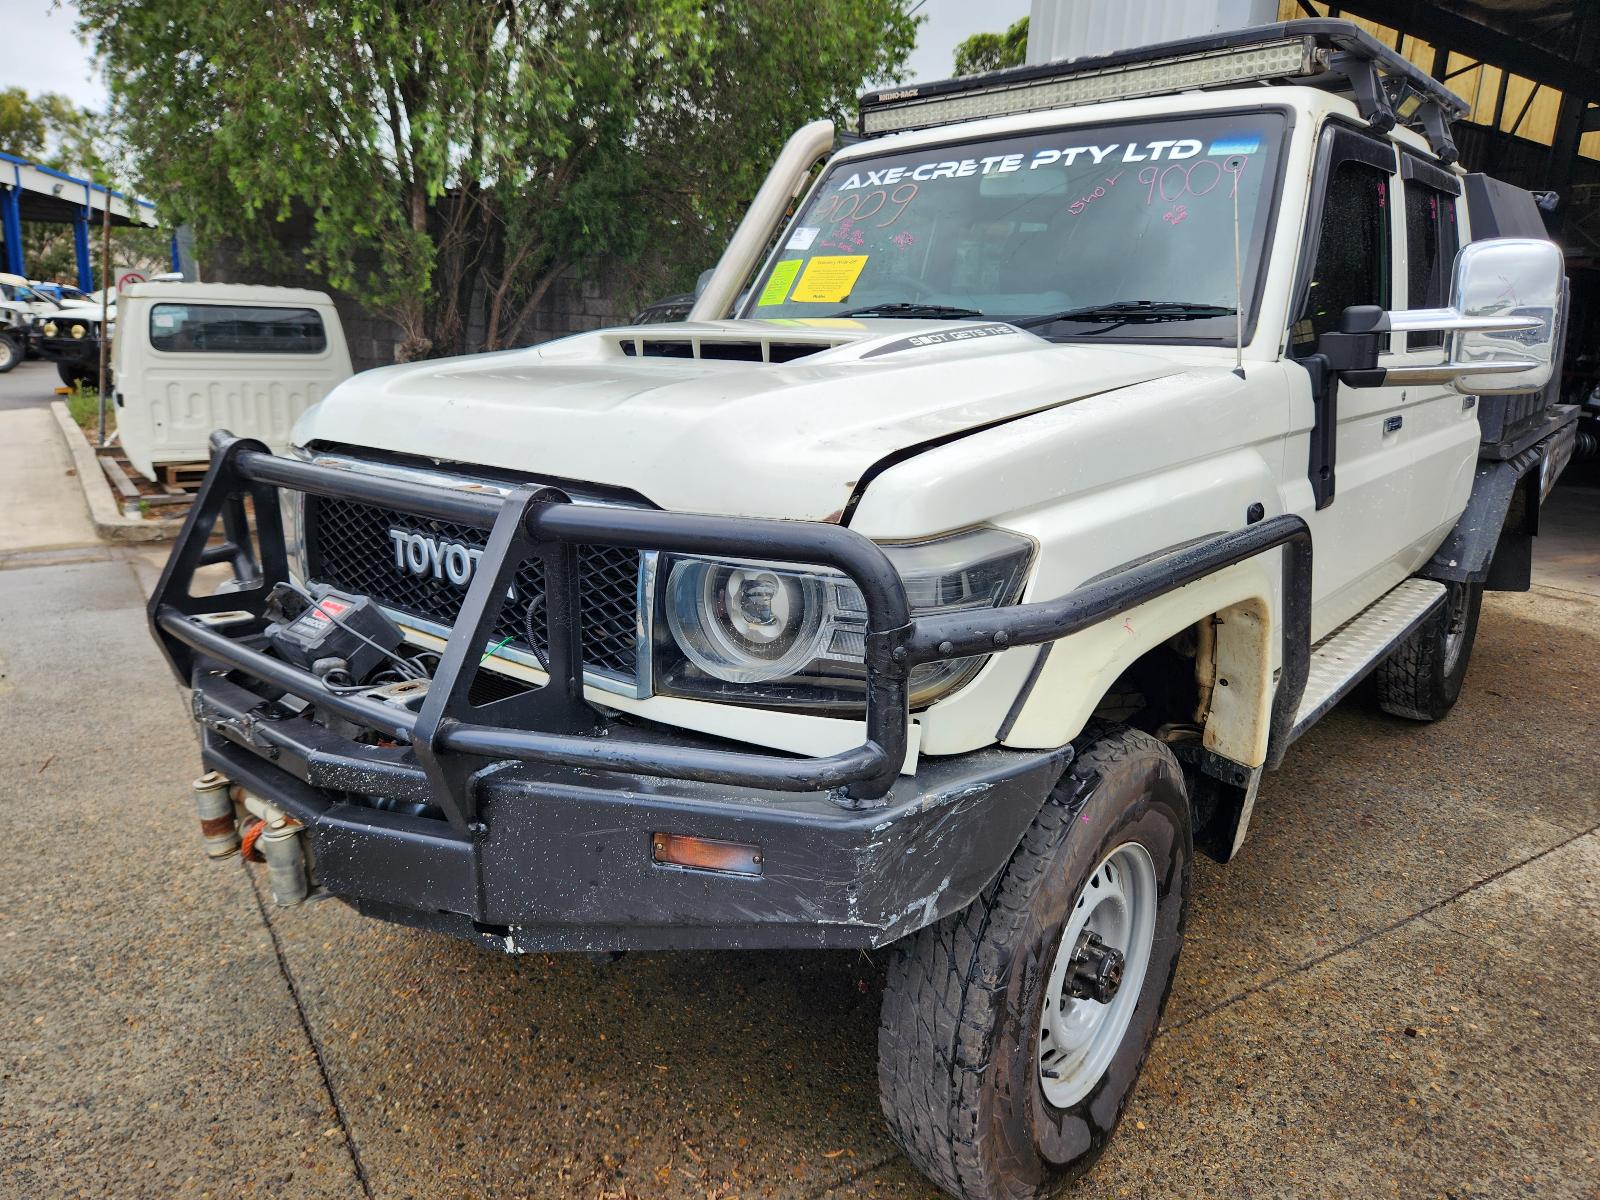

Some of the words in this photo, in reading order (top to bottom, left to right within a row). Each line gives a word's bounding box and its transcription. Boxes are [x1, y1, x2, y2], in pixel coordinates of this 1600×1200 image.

[837, 153, 1025, 191] AXE-CRETE
[1029, 143, 1121, 170] PTY
[1122, 139, 1203, 163] LTD
[1139, 154, 1249, 204] 9009
[951, 329, 987, 340] GETS
[986, 326, 1015, 335] THE
